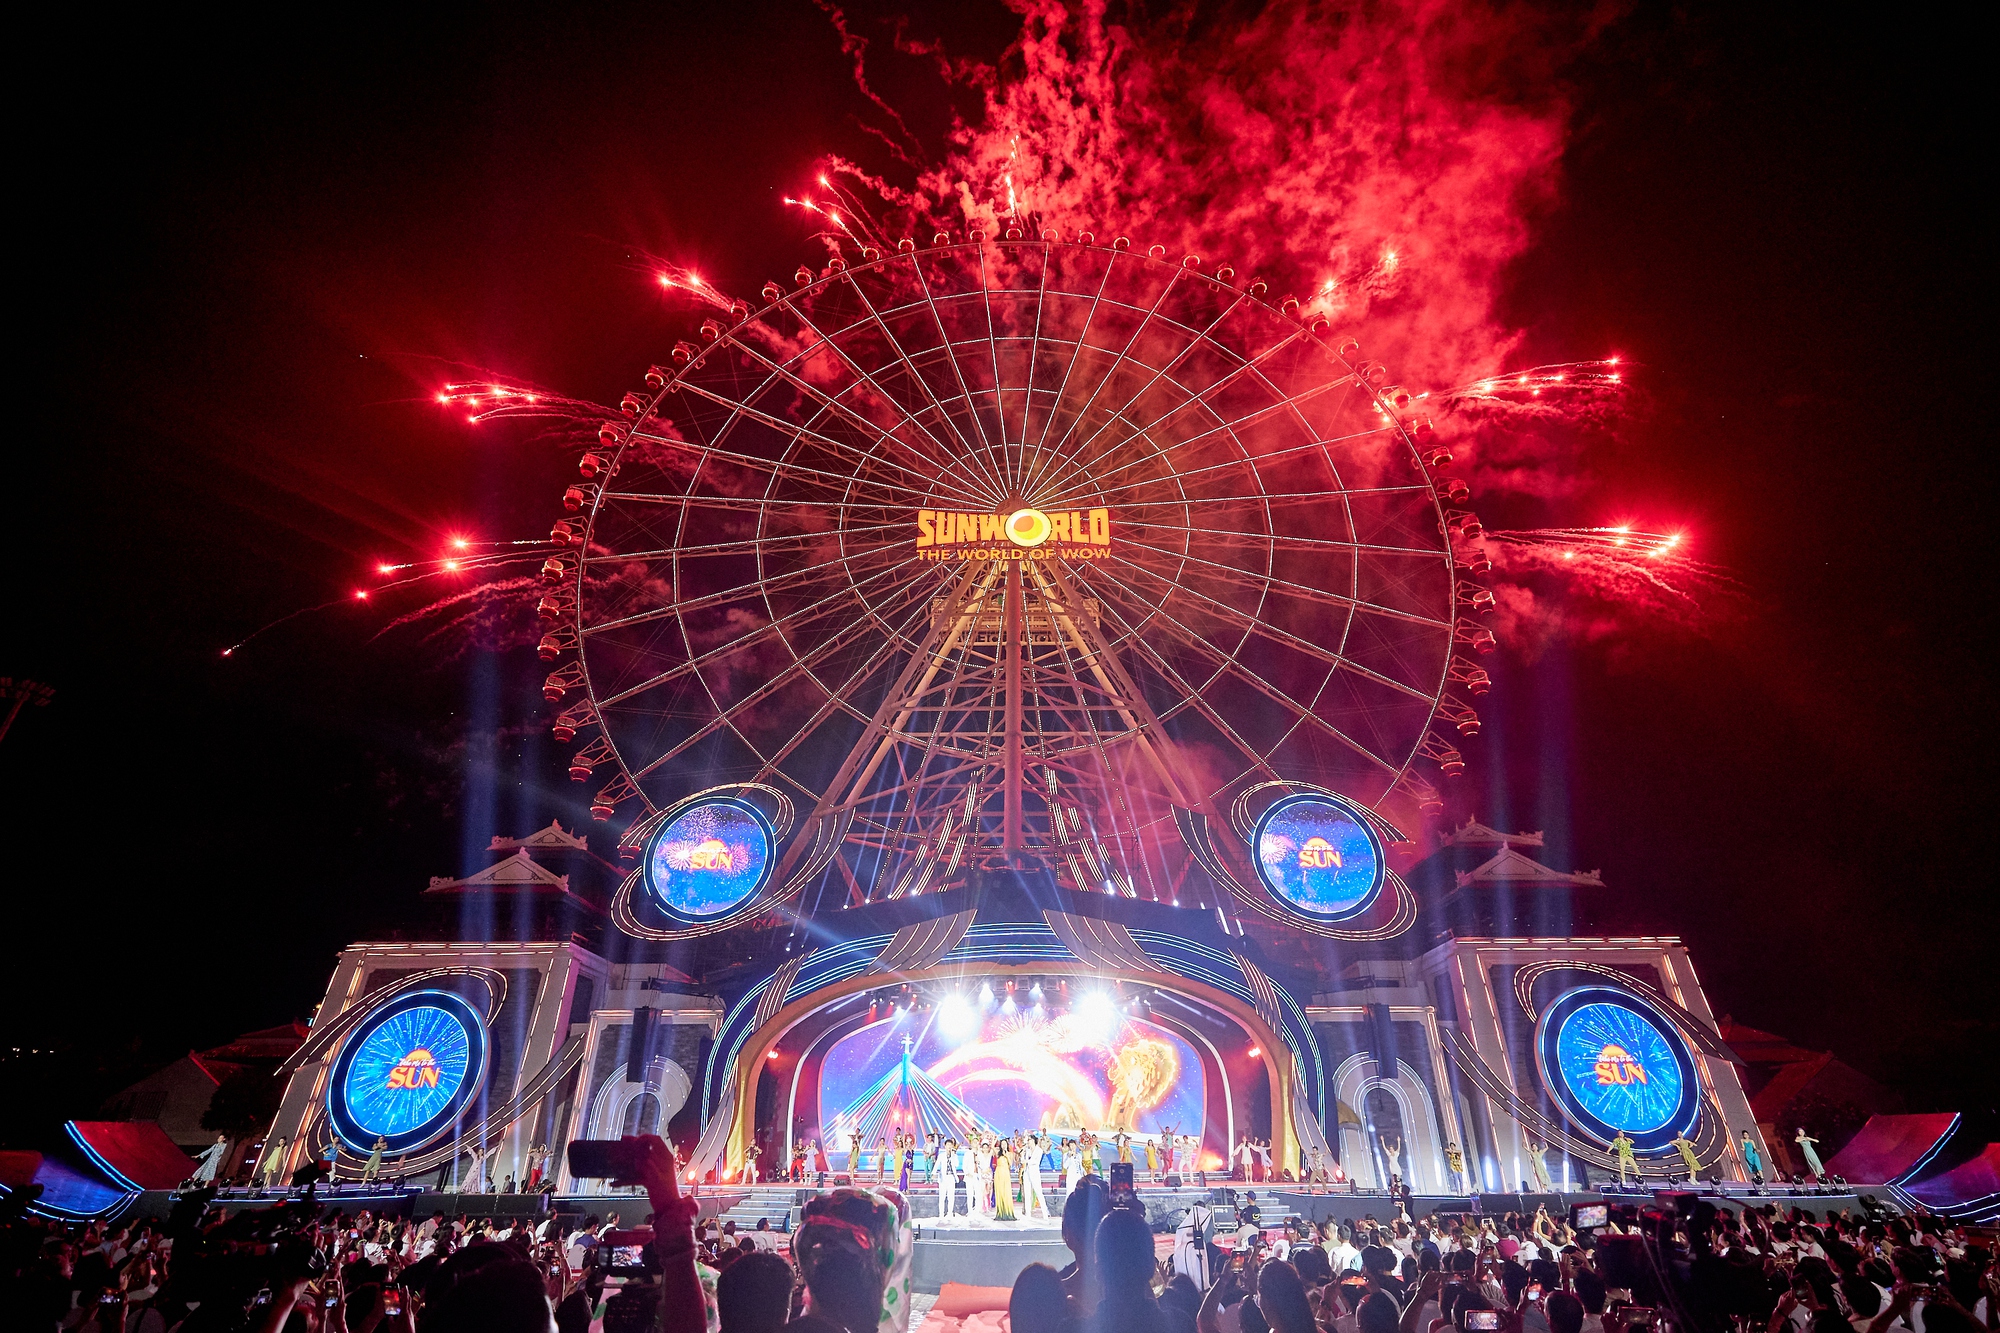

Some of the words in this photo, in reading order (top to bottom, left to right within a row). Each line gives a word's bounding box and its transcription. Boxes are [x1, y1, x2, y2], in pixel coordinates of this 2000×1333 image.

[916, 549, 951, 561] THE
[957, 549, 1024, 560] WORLD
[1030, 548, 1055, 560] OF
[1061, 547, 1112, 559] WOW
[691, 851, 733, 870] SUN
[1298, 850, 1342, 868] SUN
[386, 1066, 440, 1089] SUN
[1595, 1062, 1647, 1085] SUN
